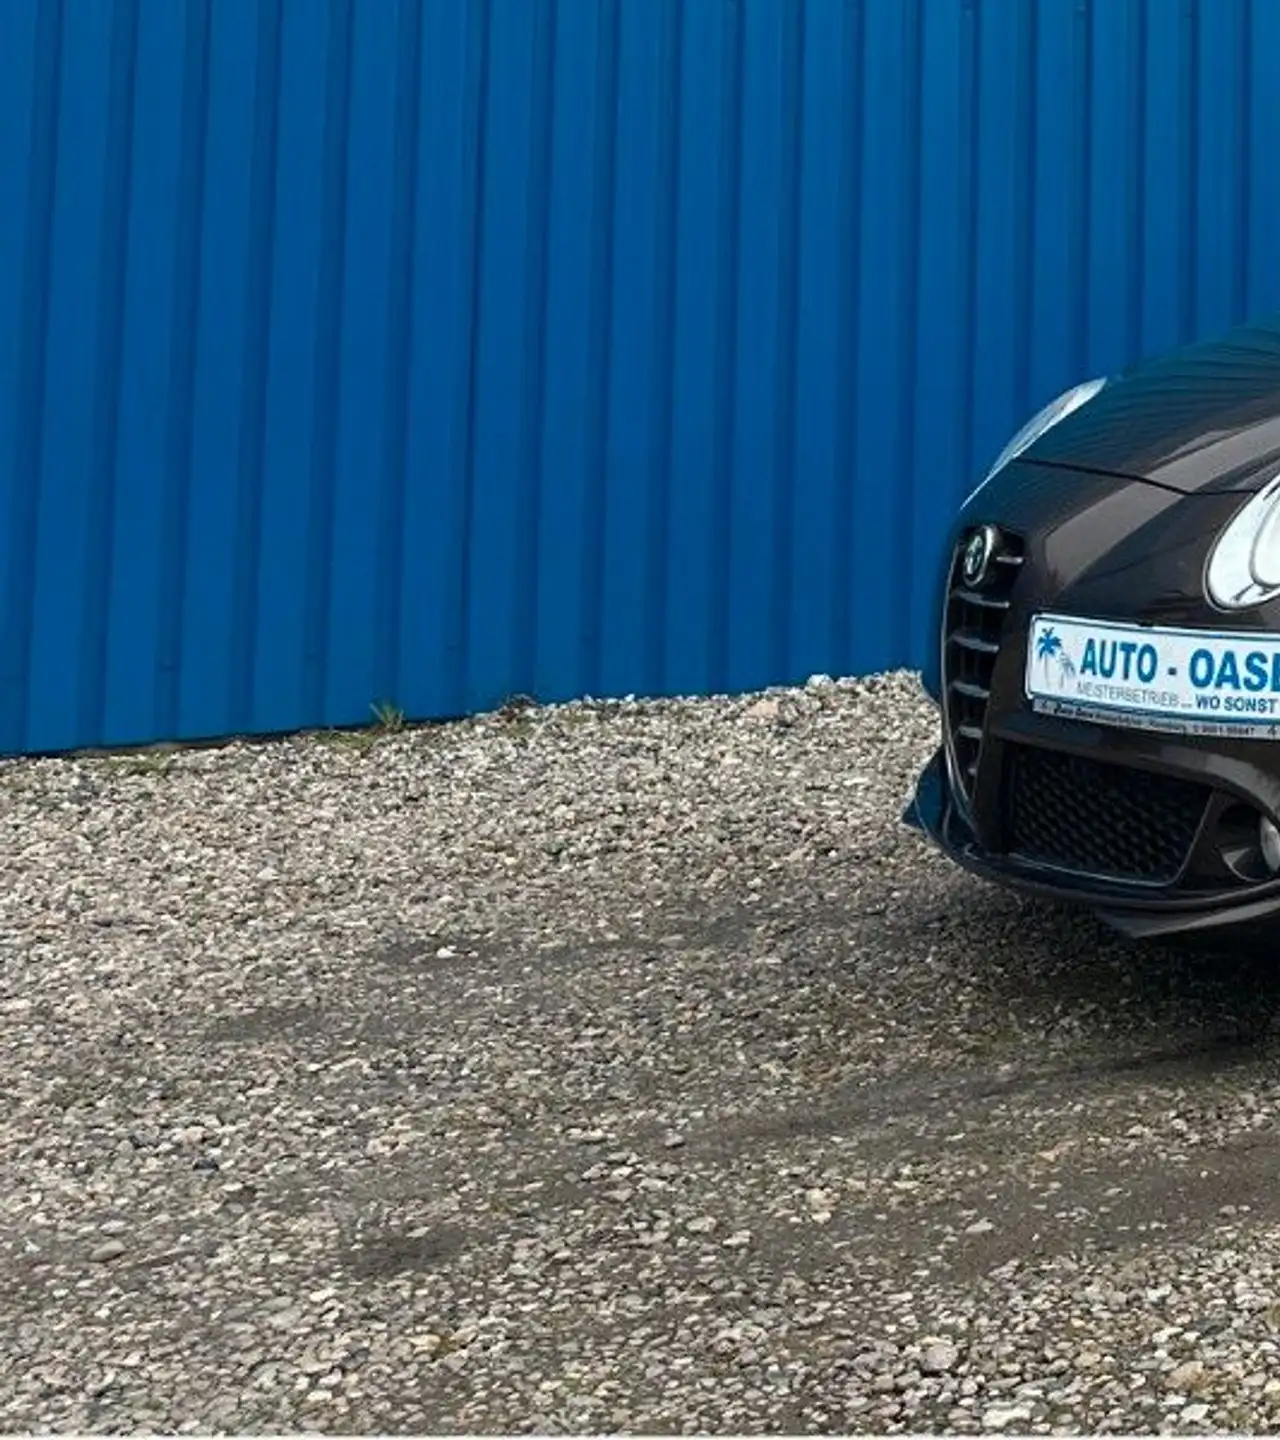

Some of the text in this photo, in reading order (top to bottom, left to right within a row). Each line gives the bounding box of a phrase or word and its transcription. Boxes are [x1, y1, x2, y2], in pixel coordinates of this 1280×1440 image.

[1080, 638, 1159, 684] AUTO
[1195, 694, 1221, 711] WO
[1223, 696, 1279, 714] SONST
